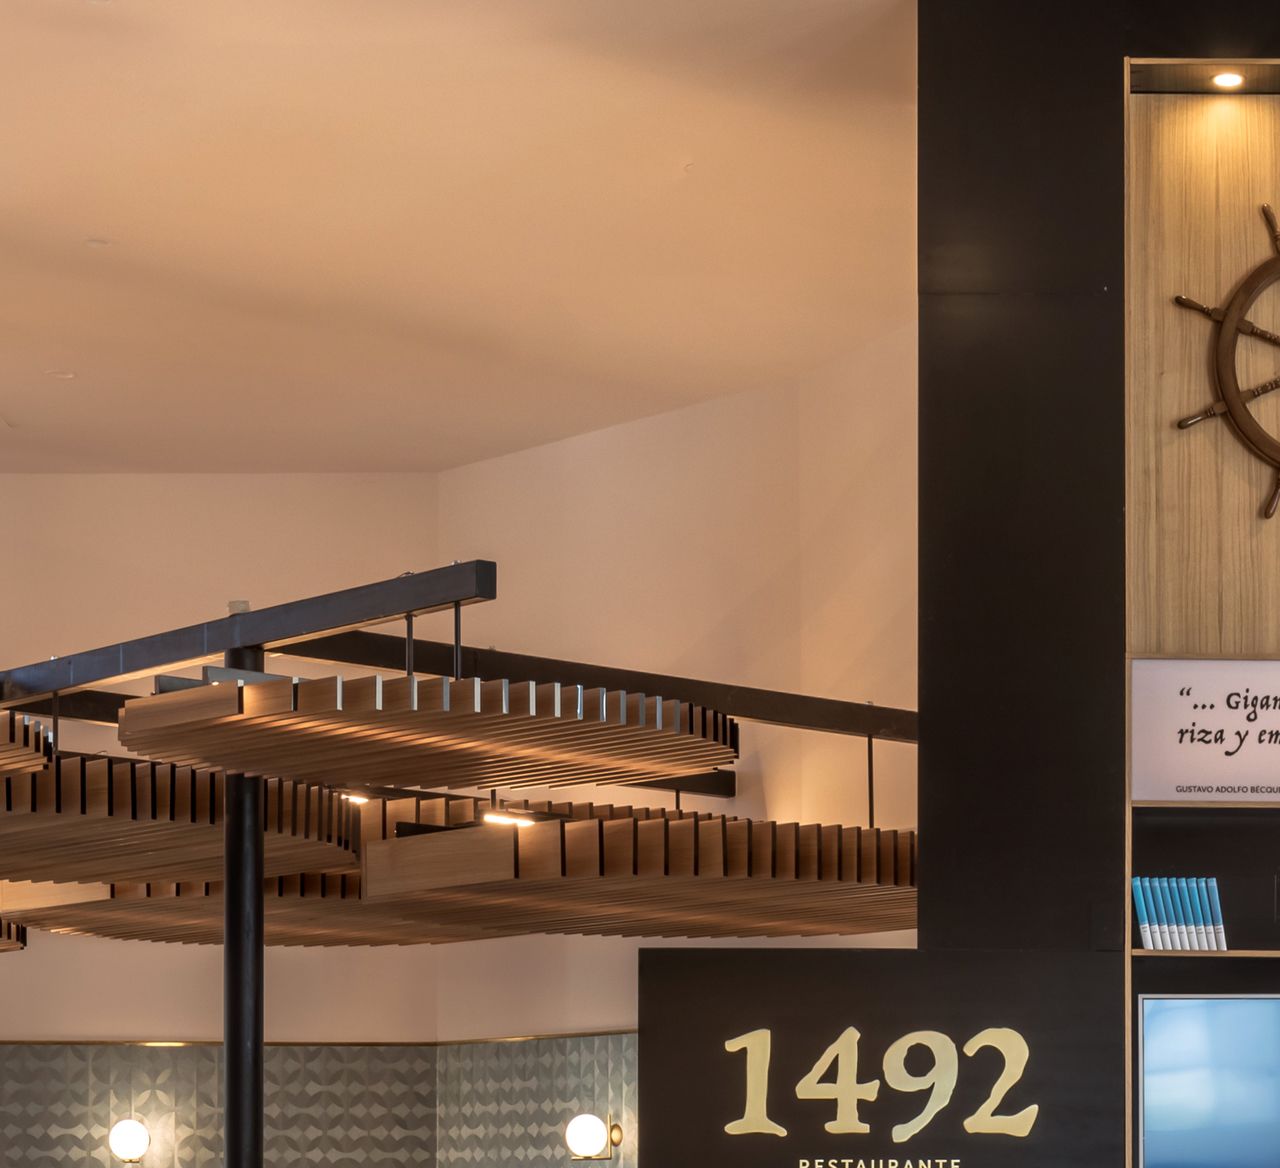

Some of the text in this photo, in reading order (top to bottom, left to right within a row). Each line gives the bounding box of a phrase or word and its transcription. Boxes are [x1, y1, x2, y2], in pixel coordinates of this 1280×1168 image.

[1178, 722, 1225, 744] riza
[1225, 729, 1248, 756] y
[1175, 785, 1214, 794] GUSTAVO
[1215, 785, 1249, 794] ADOLFO
[723, 1026, 1039, 1143] 1492
